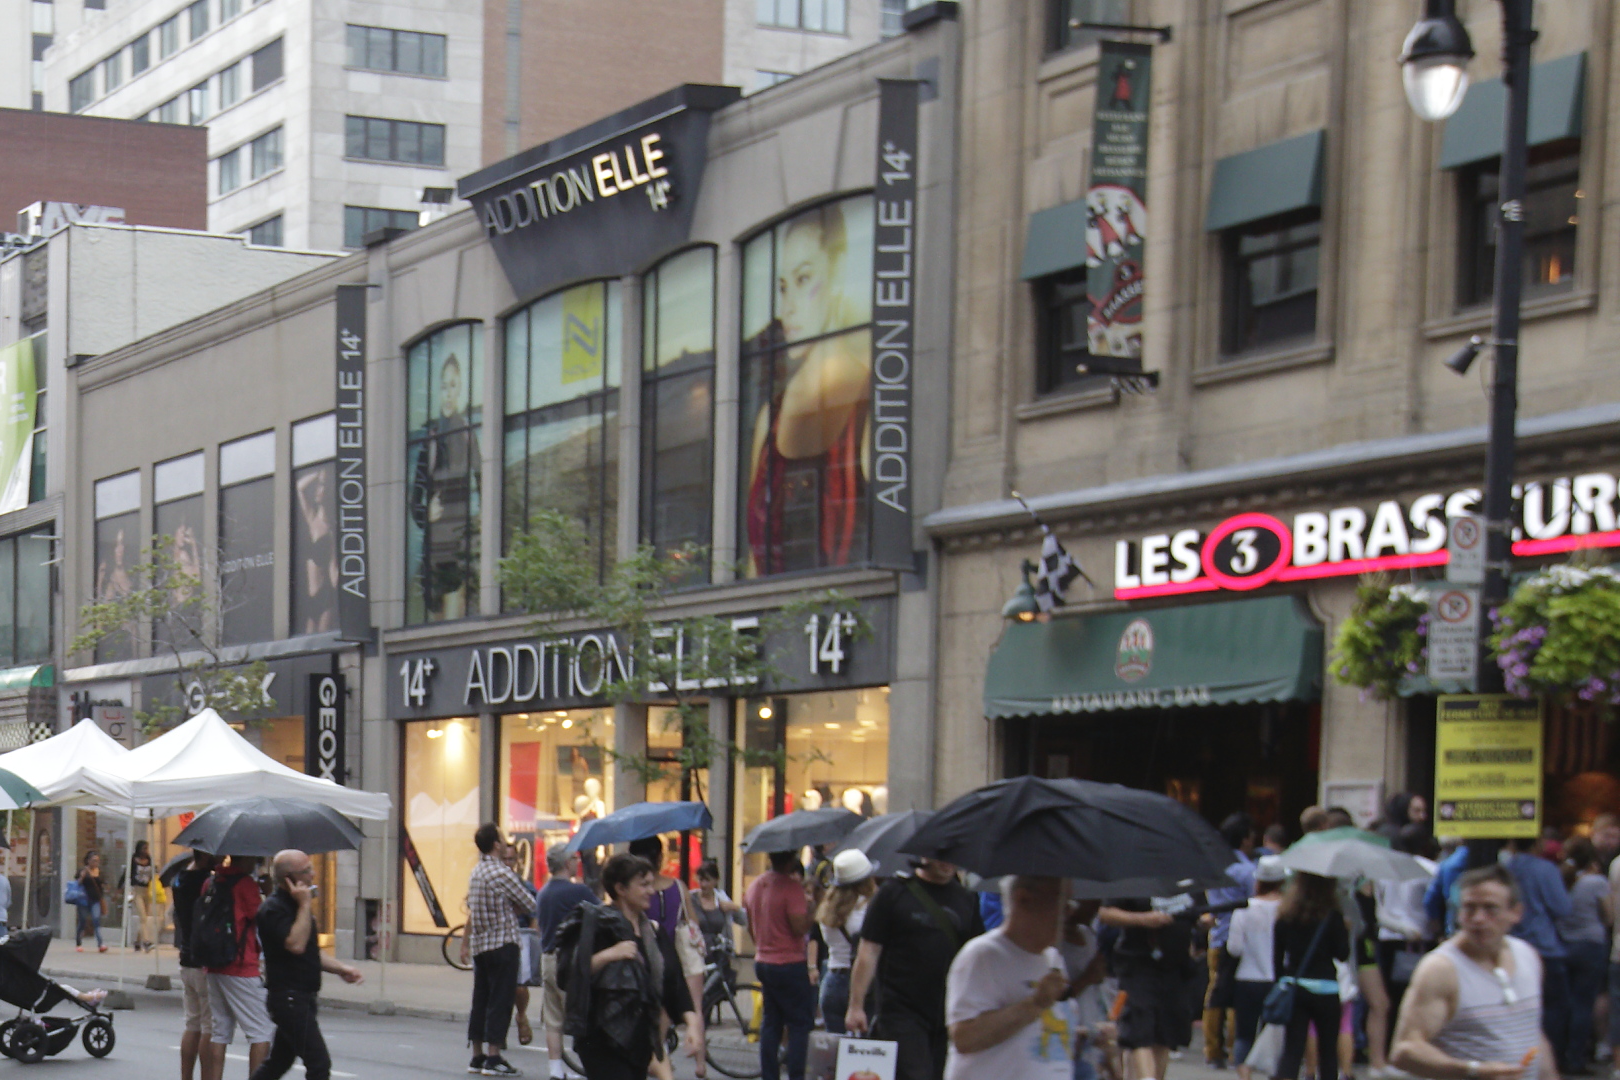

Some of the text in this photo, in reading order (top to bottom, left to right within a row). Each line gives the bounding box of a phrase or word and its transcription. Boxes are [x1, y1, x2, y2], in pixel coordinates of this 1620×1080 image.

[484, 132, 668, 238] ADDITION ELLE
[875, 200, 912, 307] ELLE
[339, 371, 363, 448] ELLE
[874, 320, 910, 514] ADDITION
[339, 457, 366, 598] ADDITION
[1115, 528, 1202, 589] LES
[1230, 529, 1259, 574] 3
[400, 657, 435, 707] 14+
[464, 633, 635, 705] ADDITION
[804, 611, 858, 674] 14+
[318, 677, 338, 784] GEOX
[848, 1044, 887, 1057] Breville
